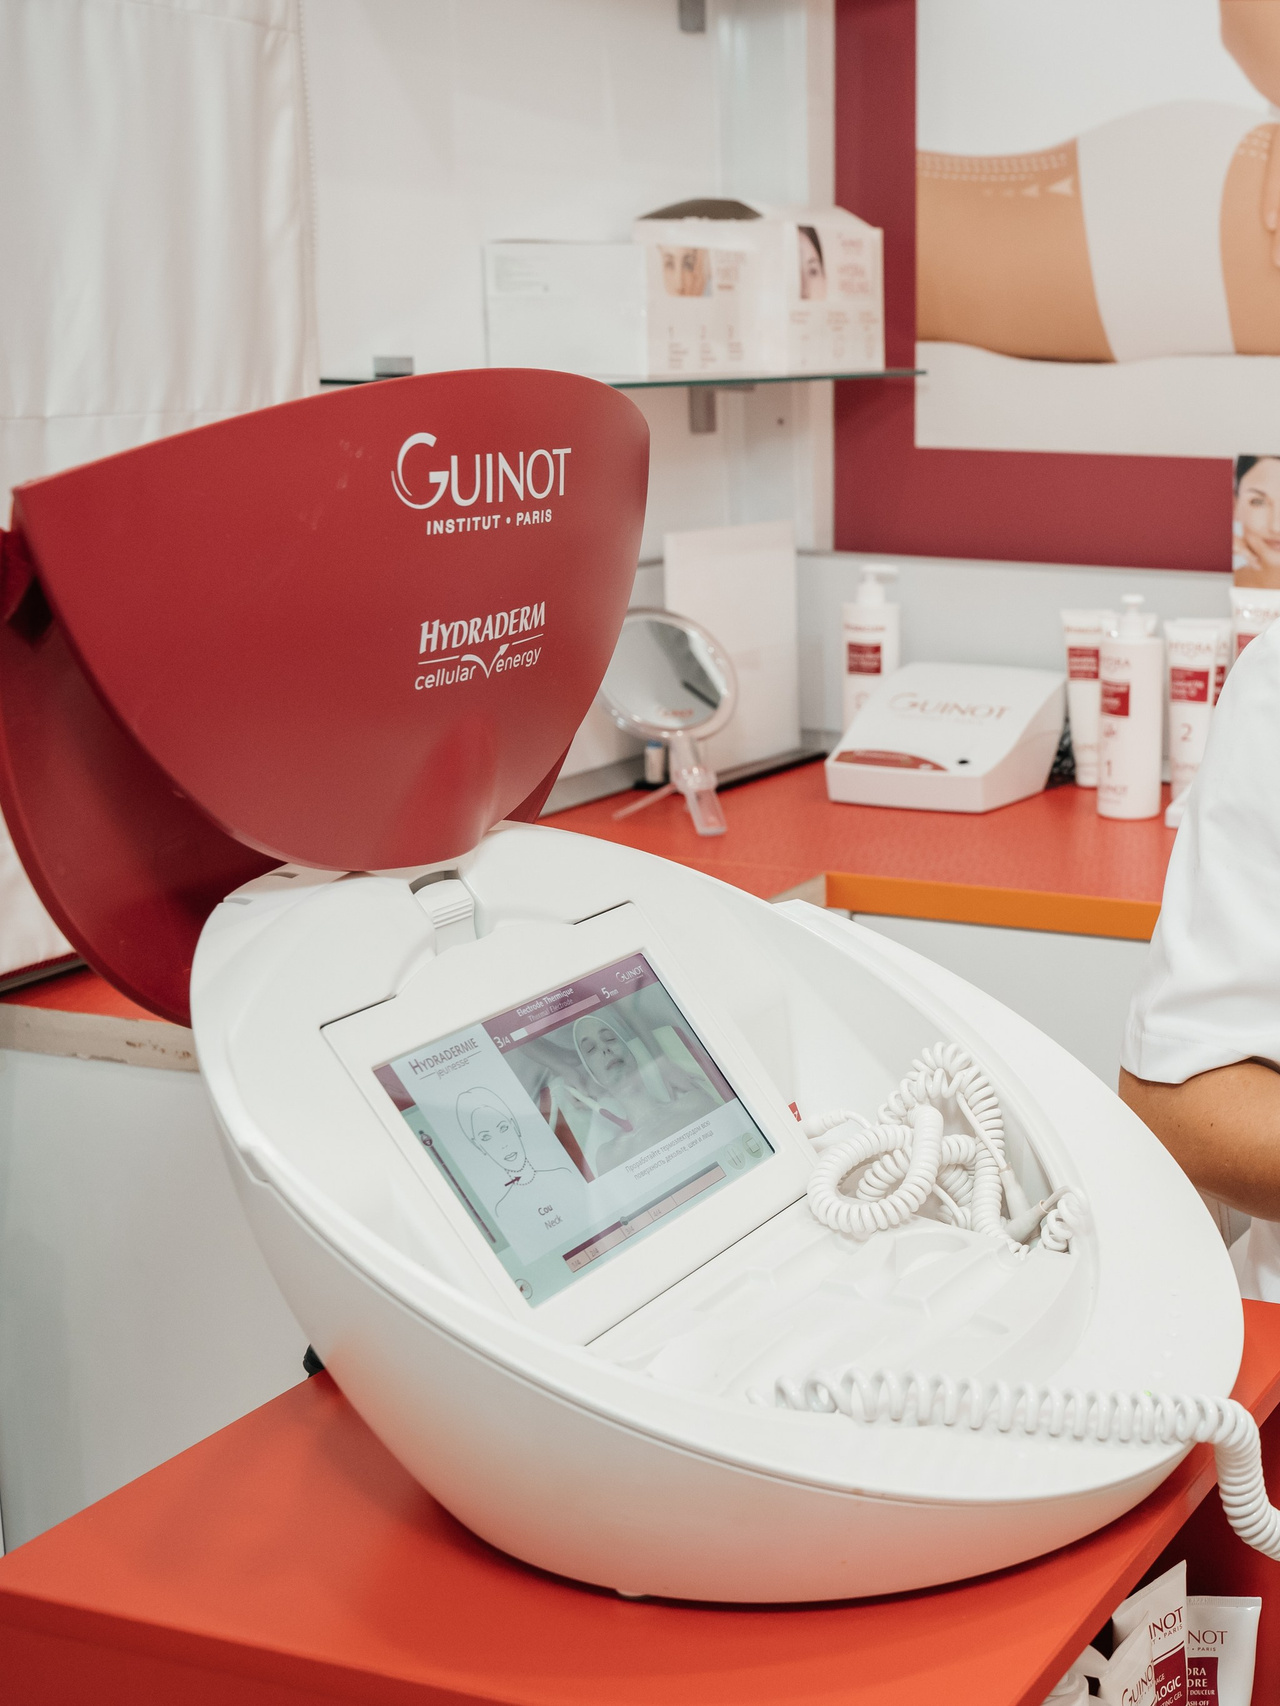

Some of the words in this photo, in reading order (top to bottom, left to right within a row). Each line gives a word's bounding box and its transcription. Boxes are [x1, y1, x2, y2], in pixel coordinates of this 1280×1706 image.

[391, 432, 572, 510] GUINOT
[426, 514, 501, 535] INSTITUT
[516, 508, 552, 526] PARIS
[419, 601, 546, 654] HYDRADERM
[414, 664, 477, 690] cellular
[495, 647, 542, 673] energy
[889, 692, 1011, 719] GUINOT
[1180, 723, 1193, 742] 2
[615, 965, 644, 983] GUINOT
[516, 999, 544, 1017] Electrode
[542, 987, 574, 1005] Thermique
[528, 1008, 549, 1022] Thermal
[549, 998, 573, 1013] Electrode
[493, 1035, 511, 1049] 3/4
[408, 1037, 479, 1075] HYDRADERMIE
[435, 1056, 470, 1080] jeunesse
[537, 1203, 553, 1216] Cou
[544, 1214, 563, 1231] Neck
[1148, 1605, 1184, 1640] INOT
[1163, 1624, 1184, 1638] PARIS
[1187, 1629, 1228, 1645] NOT
[1121, 1664, 1154, 1706] GUINO
[1156, 1675, 1182, 1702] LOGIC
[1187, 1678, 1208, 1688] DRE
